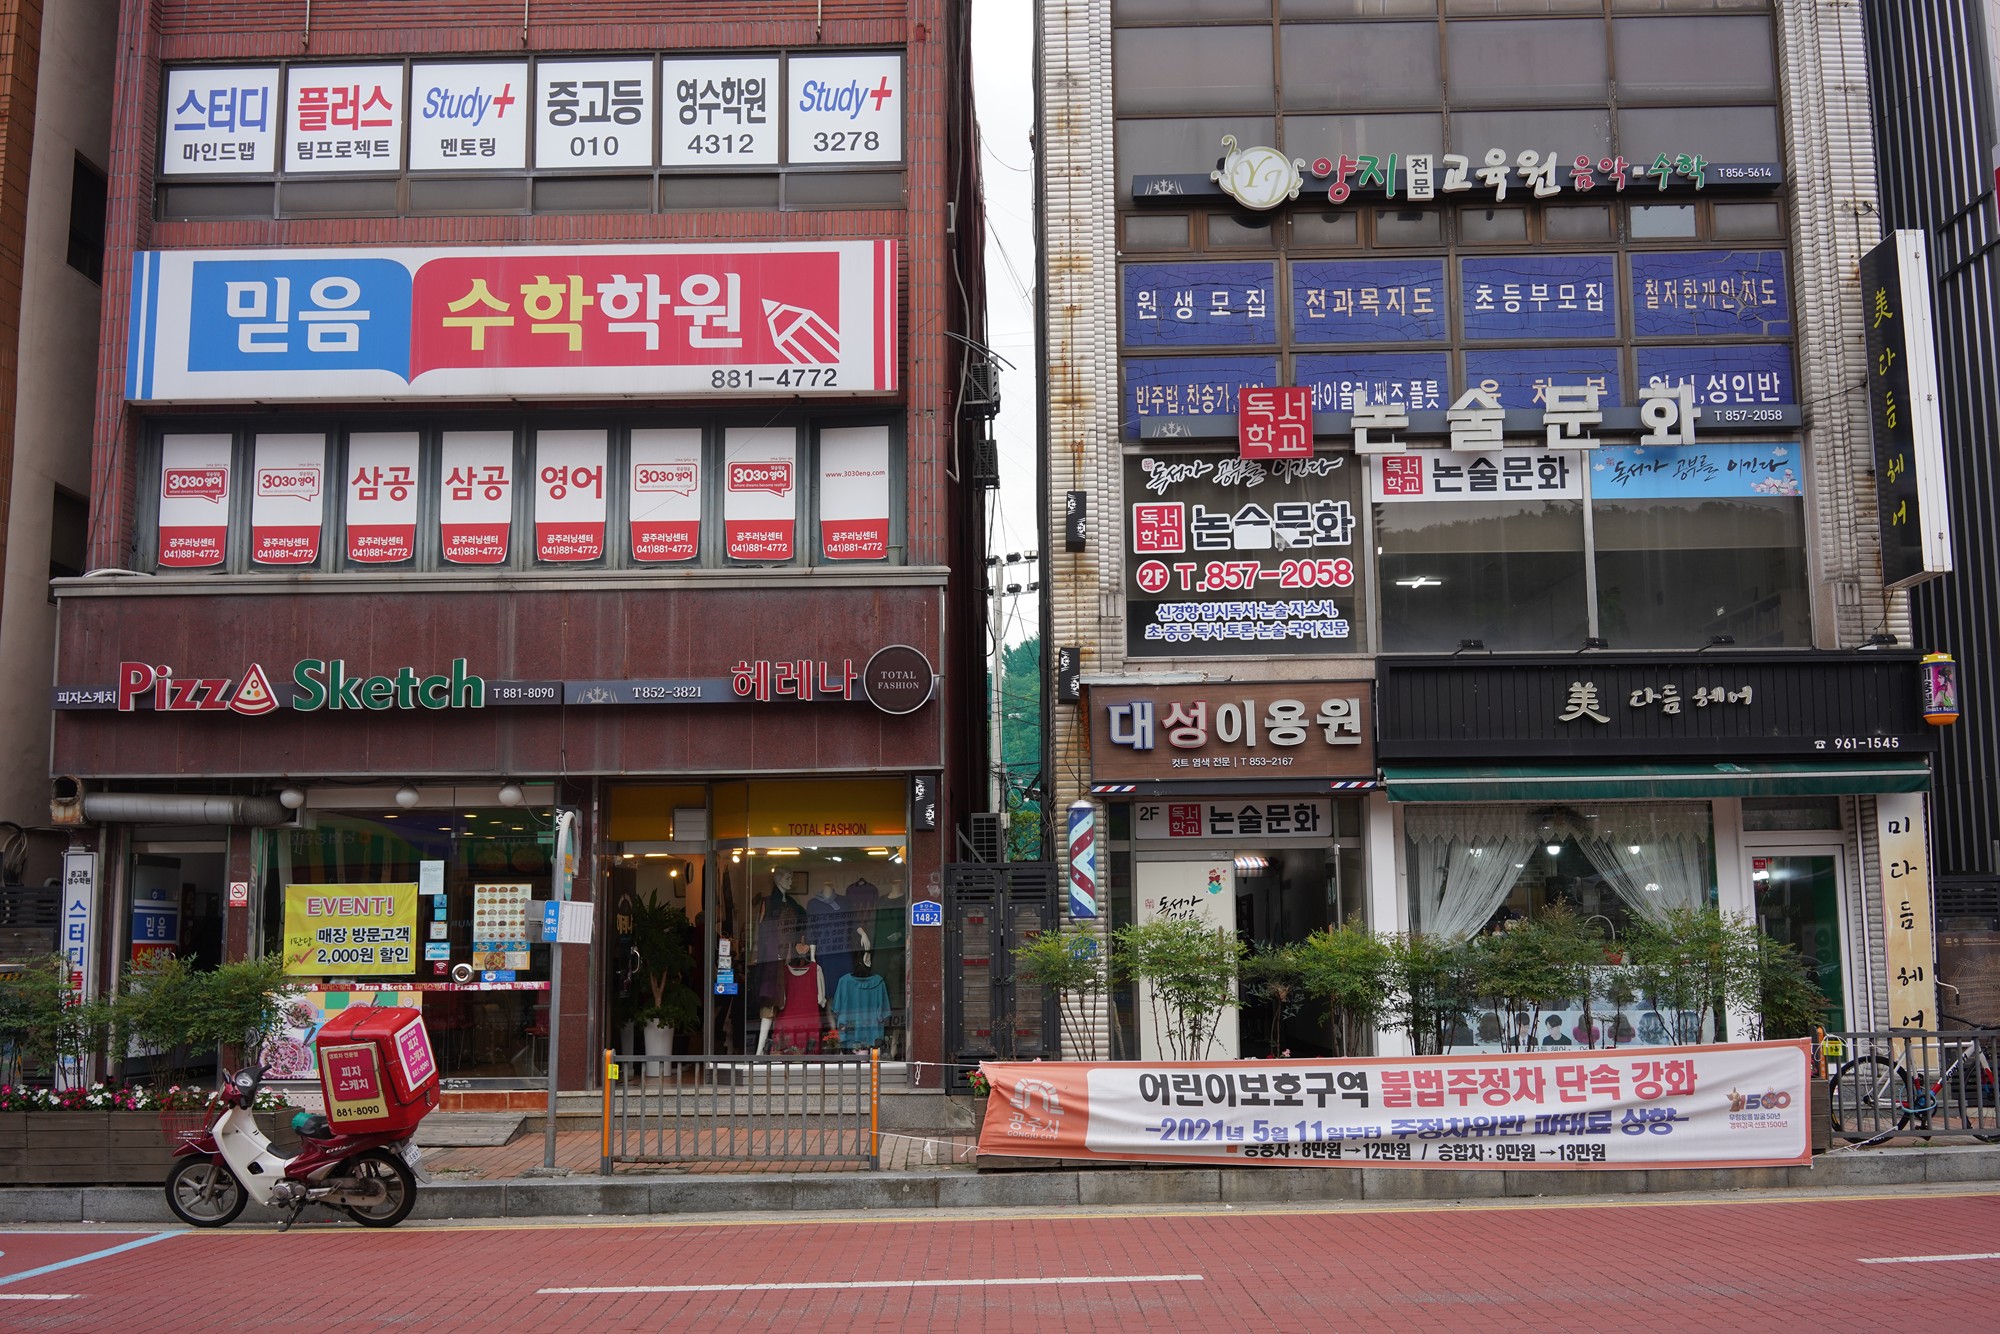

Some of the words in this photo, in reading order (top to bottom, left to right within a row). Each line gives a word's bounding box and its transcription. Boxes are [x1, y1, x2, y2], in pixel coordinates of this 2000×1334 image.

[174, 86, 268, 132] 스터디
[298, 84, 392, 131] 플러스
[547, 79, 643, 126] 중고등
[676, 78, 766, 125] 영수학원
[441, 138, 496, 158] 멘토링
[570, 136, 619, 157] 010
[688, 134, 753, 154] 4312
[813, 131, 880, 151] 3278
[183, 141, 256, 162] 마인드맵
[297, 140, 390, 160] 팀프로젝트
[1312, 153, 1397, 205] 양지
[1411, 158, 1432, 195] 전문
[1442, 148, 1561, 203] 교육원
[1475, 282, 1604, 313] 초등부모집
[1644, 278, 1777, 310] 철저한개인지도
[1306, 287, 1435, 319] 전과목지도
[225, 276, 370, 353] 믿음
[442, 272, 743, 352] 수학학원
[710, 368, 837, 389] 881-4772
[1246, 392, 1307, 422] 독서
[1351, 384, 1701, 453] 논술문화
[1246, 423, 1308, 454] 학교
[825, 469, 885, 479] www.3030eng.com
[1387, 458, 1419, 475] 독서
[1432, 454, 1570, 493] 논술문화
[352, 466, 415, 501] 삼공
[445, 466, 510, 501] 삼공
[541, 465, 603, 500] 영어
[1387, 476, 1421, 494] 학교
[1140, 508, 1178, 527] 독서
[170, 537, 215, 548] 공주러닝센터
[263, 537, 309, 547] 공주러닝센터
[357, 536, 404, 546] 공주러닝센터
[452, 534, 498, 545] 공주러닝센터
[547, 533, 593, 543] 공주러닝센터
[642, 532, 688, 543] 공주러닝센터
[736, 531, 783, 542] 공주러닝센터
[832, 531, 878, 541] 공주러닝센터
[1140, 530, 1179, 548] 학교
[164, 549, 219, 559] 041)881-4772
[257, 549, 313, 559] 041)881-4772
[352, 547, 408, 557] 041)881-4772
[446, 546, 503, 556] 041)881-4772
[542, 545, 598, 555] 041)881-4772
[636, 545, 693, 554] 041)881-4772
[731, 543, 787, 553] 041)881-4772
[827, 542, 882, 552] 041)881-4772
[1142, 570, 1164, 586] 2F
[731, 659, 858, 701] 헤레나
[881, 670, 917, 680] TOTAL
[292, 658, 486, 712] Sketch
[877, 680, 920, 690] FASHION
[57, 690, 117, 704] 피자스케치
[1558, 680, 1611, 724] 美
[1629, 684, 1681, 715] 다듬
[1692, 685, 1753, 707] 헤어
[1107, 698, 1362, 749] 대성이용원
[1834, 736, 1899, 750] 961-1545
[1192, 758, 1210, 768] 염색
[1212, 757, 1230, 767] 전문
[1249, 757, 1293, 767] 853-2167
[1139, 806, 1160, 821] 2F
[1171, 806, 1199, 820] 독서
[1208, 803, 1320, 835] 논술문화
[788, 823, 819, 836] TOTAL
[824, 822, 866, 835] FASHION
[1171, 820, 1199, 835] 학교
[307, 897, 394, 916] EVENT!
[915, 913, 938, 922] 148-2
[146, 916, 166, 938] 믿음
[318, 928, 347, 943] 매장
[352, 927, 410, 943] 방문고객
[317, 947, 374, 964] 2,000원
[380, 947, 409, 963] 할인
[355, 983, 379, 991] Pizza
[381, 983, 413, 991] Sketch
[341, 1066, 361, 1078] 피자
[339, 1079, 369, 1091] 스케치
[1139, 1071, 1369, 1108] 어린이보호구역
[1381, 1067, 1546, 1108] 불법주정차
[1555, 1065, 1621, 1102] 단속
[1632, 1060, 1698, 1099] 강화
[337, 1105, 380, 1117] 881-8090
[1008, 1112, 1059, 1135] 공주시
[1253, 1119, 1289, 1142] 5월
[1295, 1119, 1381, 1142] 11일부터
[1391, 1113, 1526, 1139] 주정차위반
[1007, 1130, 1038, 1139] GONGJU
